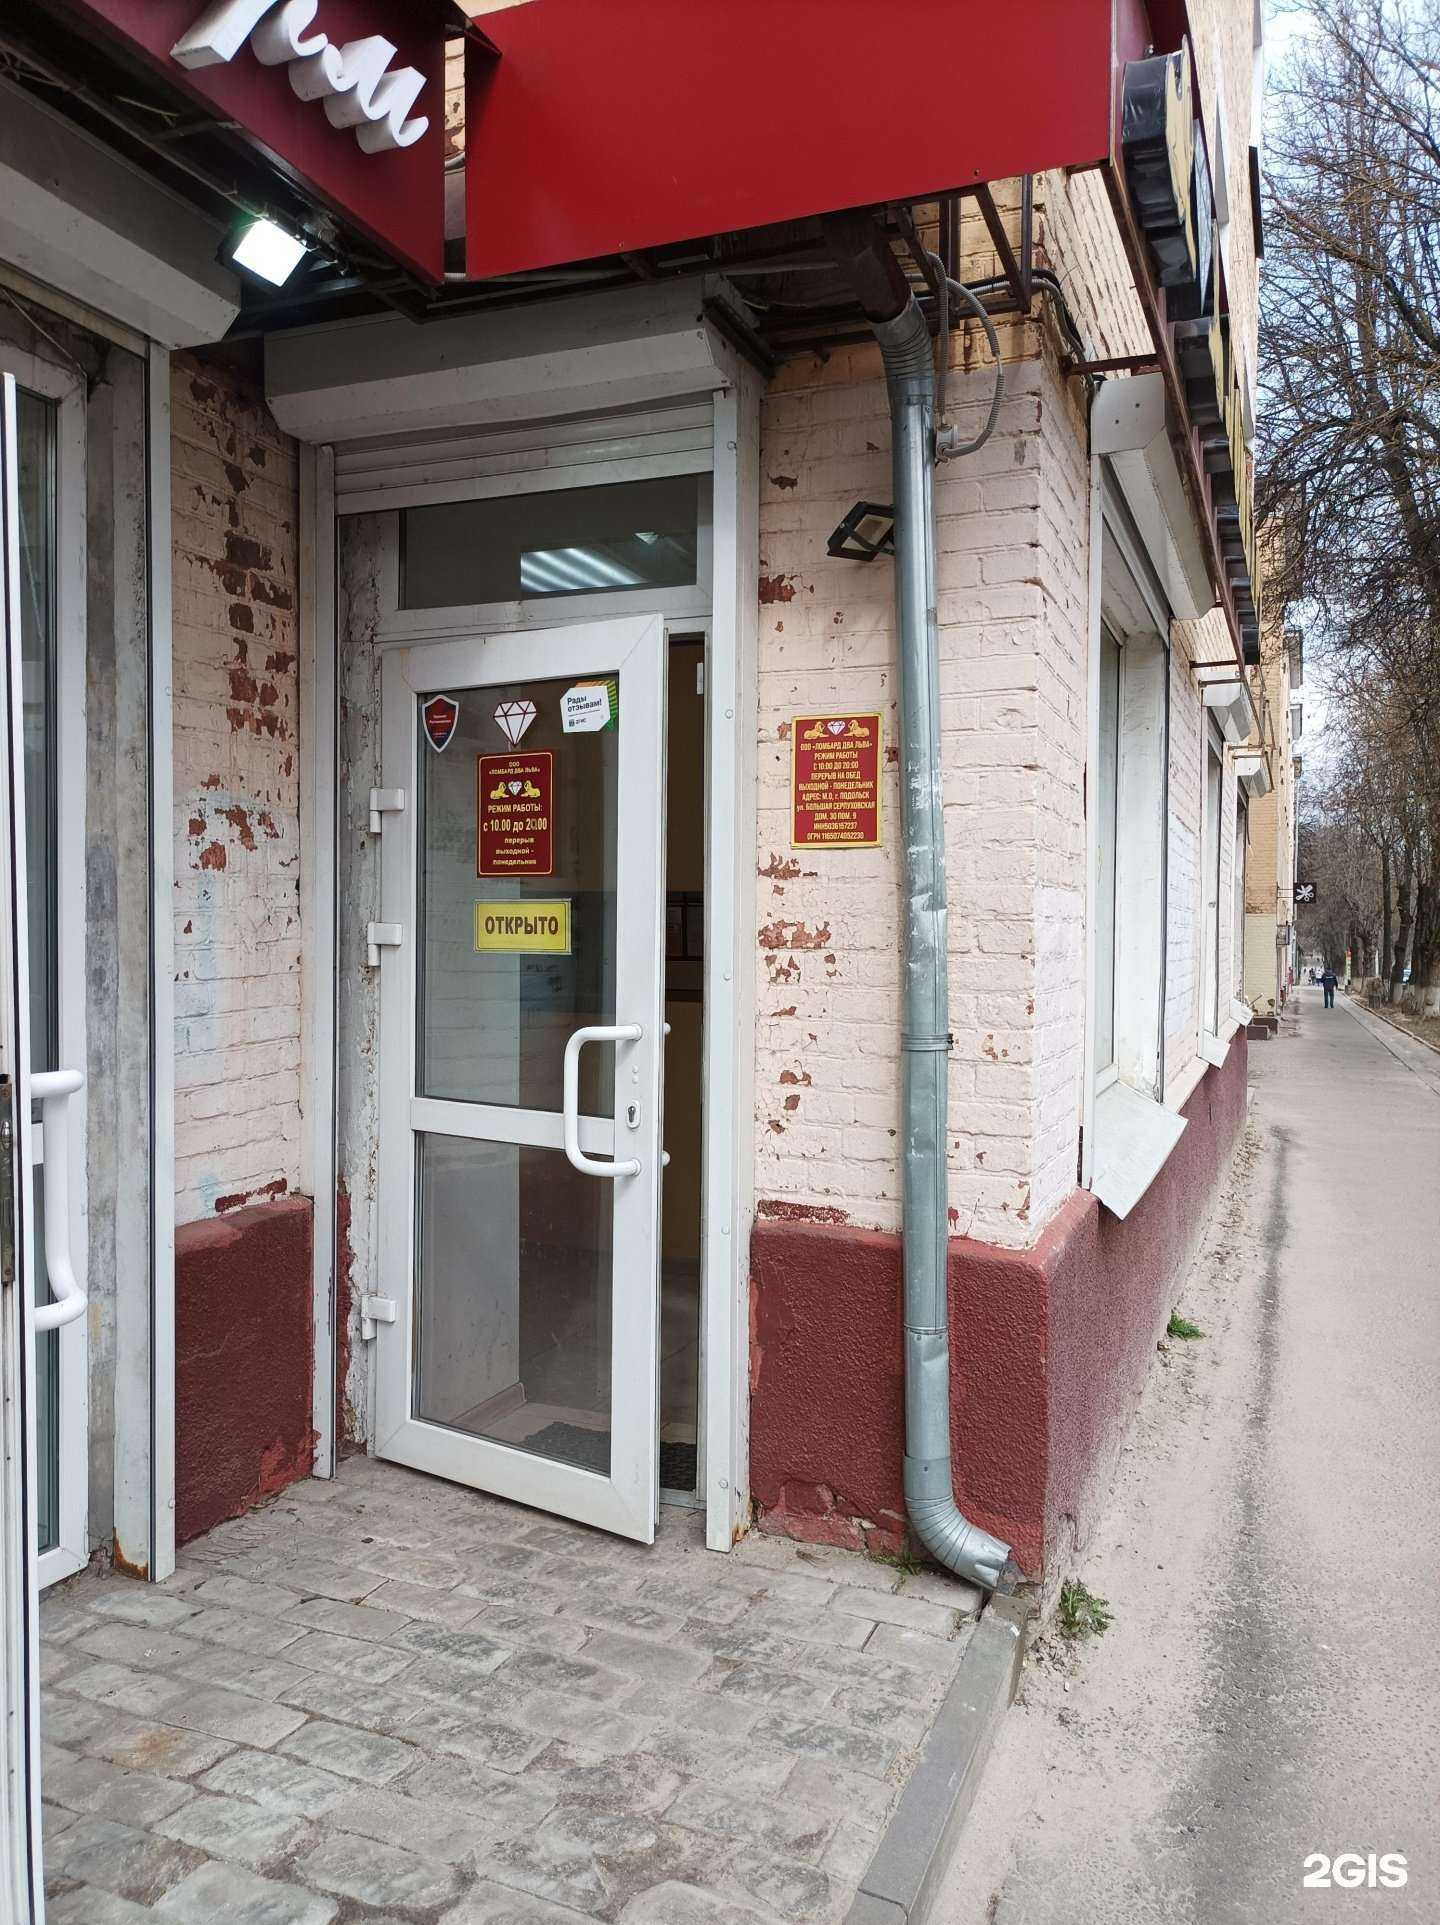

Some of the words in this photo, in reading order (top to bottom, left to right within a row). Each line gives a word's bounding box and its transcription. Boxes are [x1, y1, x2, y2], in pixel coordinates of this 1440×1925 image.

[567, 696, 587, 705] Рады
[567, 698, 602, 712] отзывам!
[800, 743, 812, 751] ООО
[842, 741, 854, 749] ДВА
[814, 752, 835, 760] РЕЖИМ
[835, 751, 859, 759] РАБОТЫ
[833, 762, 842, 770] ДО
[811, 772, 837, 780] ПЕРЕРЫВ
[837, 771, 845, 779] НА
[845, 771, 861, 779] ОБЕД
[798, 781, 829, 791] ВЫХОДНОЙ
[832, 781, 874, 790] ПОНЕДЕЛЬНИК
[802, 793, 822, 801] АДРЕС:
[839, 791, 870, 799] ПОДОЛЬСК
[488, 804, 511, 813] РЕЖИМ
[512, 803, 543, 812] РАБОТЫ:
[805, 802, 832, 811] БОЛЬШАЯ
[833, 801, 876, 810] СЕРПУХОВСКАЯ
[490, 819, 511, 832] 10.00
[512, 821, 524, 833] до
[525, 817, 548, 831] 20.00
[806, 832, 820, 840] ОГРН
[495, 847, 530, 855] выходной
[484, 915, 559, 936] ОТКРЫТО
